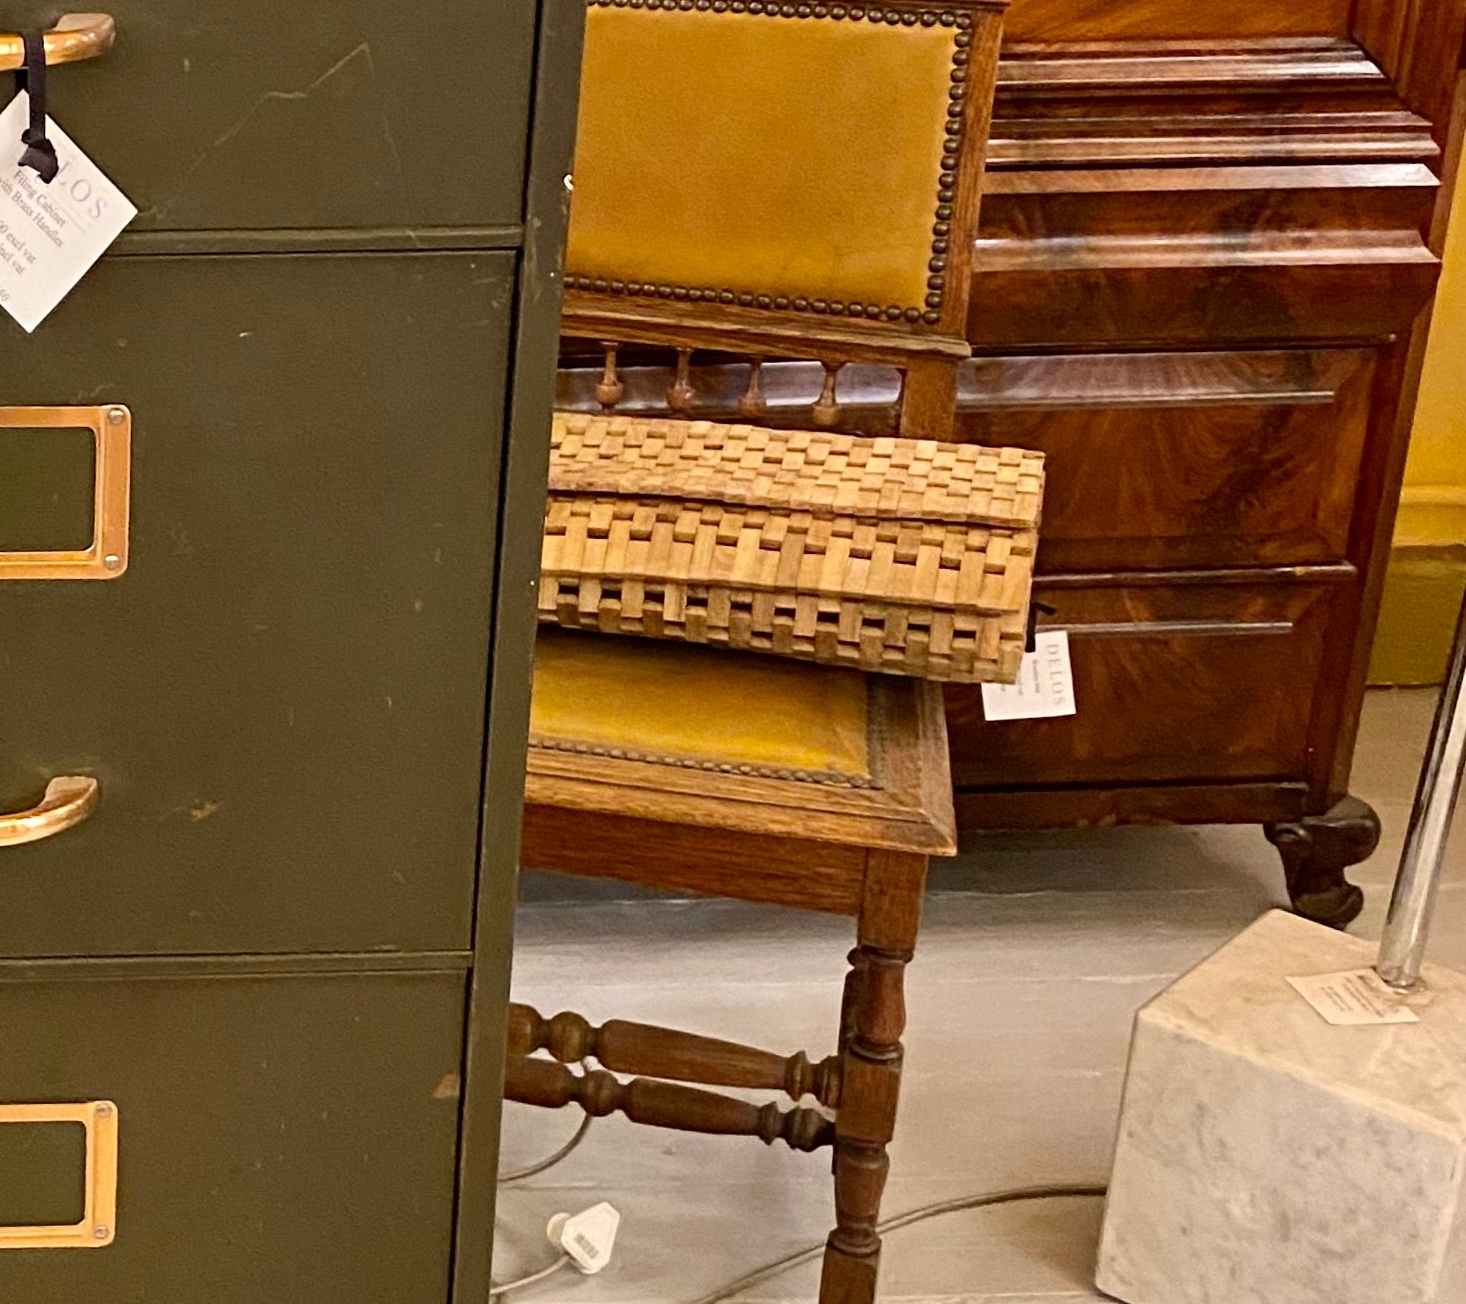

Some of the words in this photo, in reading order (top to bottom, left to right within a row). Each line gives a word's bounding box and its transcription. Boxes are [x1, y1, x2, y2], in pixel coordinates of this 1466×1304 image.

[11, 170, 40, 200] Filing
[35, 194, 68, 228] Cabinet
[55, 161, 110, 220] LOS
[5, 232, 26, 252] excl
[21, 249, 38, 265] vat
[11, 193, 36, 218] Brass
[32, 214, 66, 248] Handles
[10, 259, 26, 275] vat
[1046, 644, 1065, 706] DELOS
